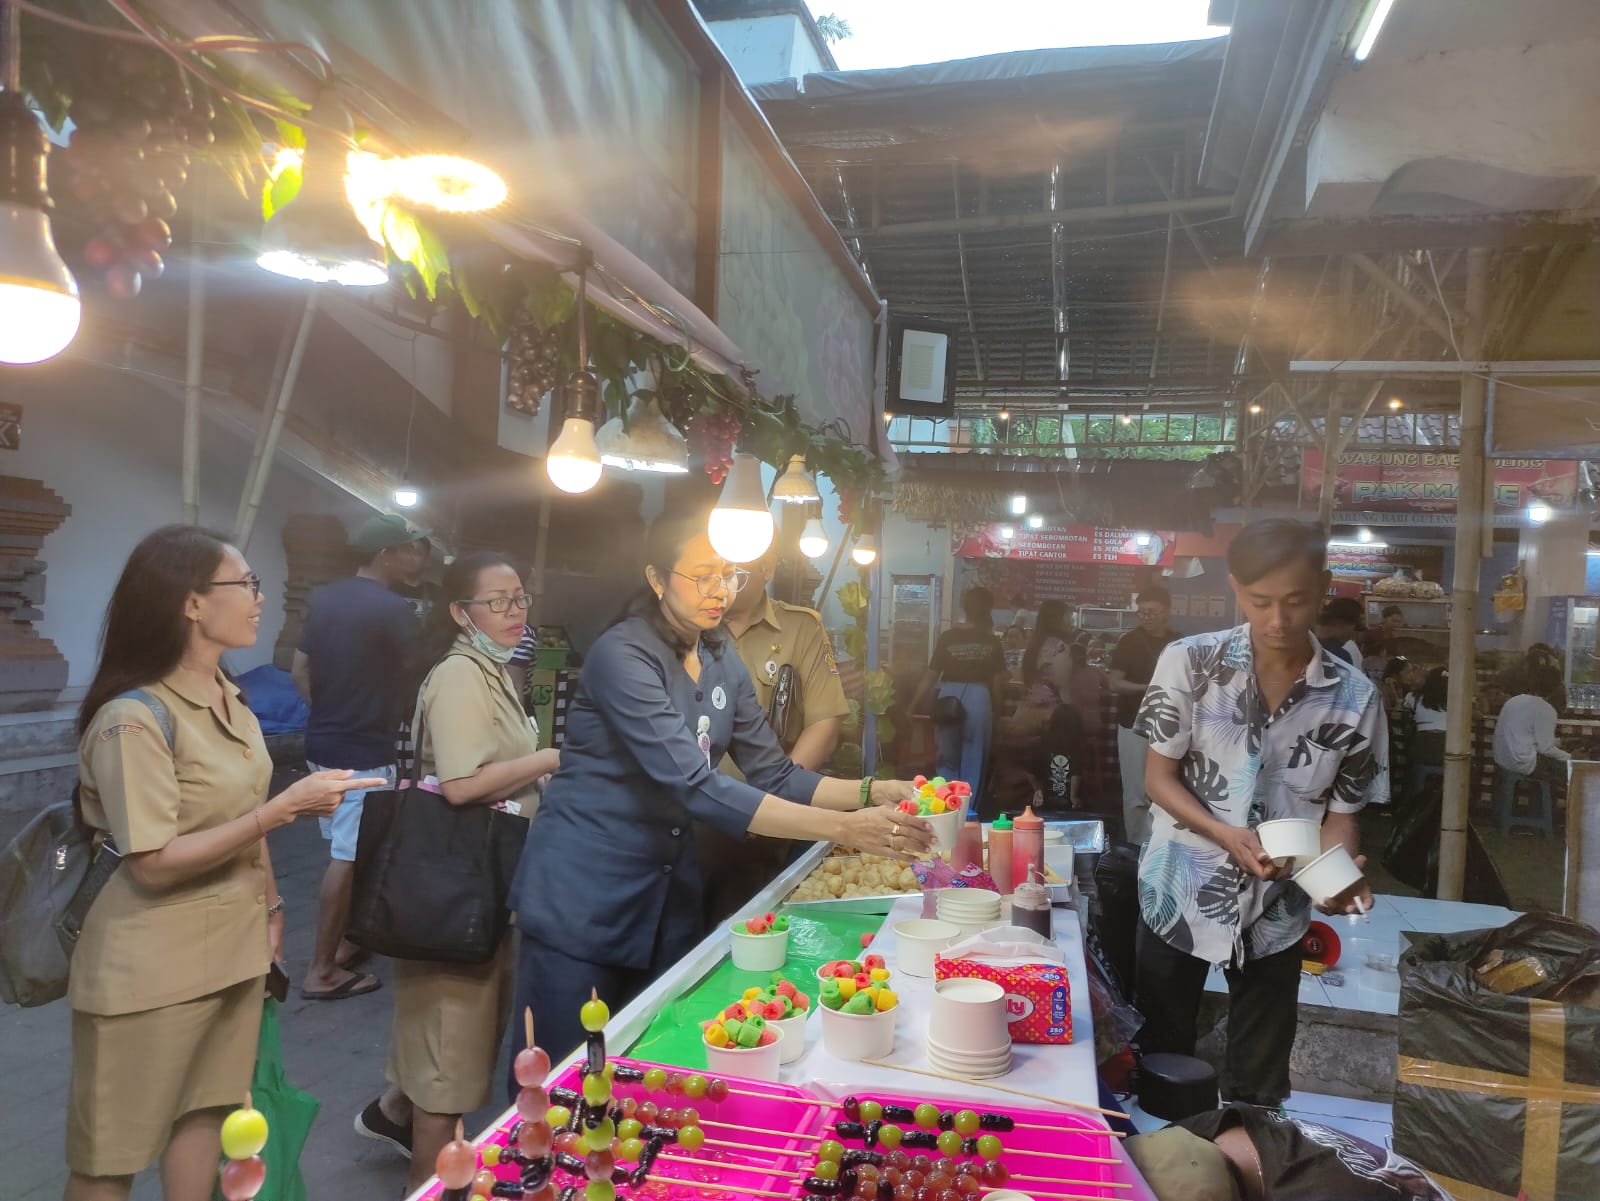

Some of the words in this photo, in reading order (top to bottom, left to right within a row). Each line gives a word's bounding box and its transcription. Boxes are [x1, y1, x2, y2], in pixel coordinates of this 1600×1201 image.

[1338, 452, 1418, 467] WARUNG
[1353, 481, 1419, 503] PAK
[1018, 550, 1038, 558] TIPAT
